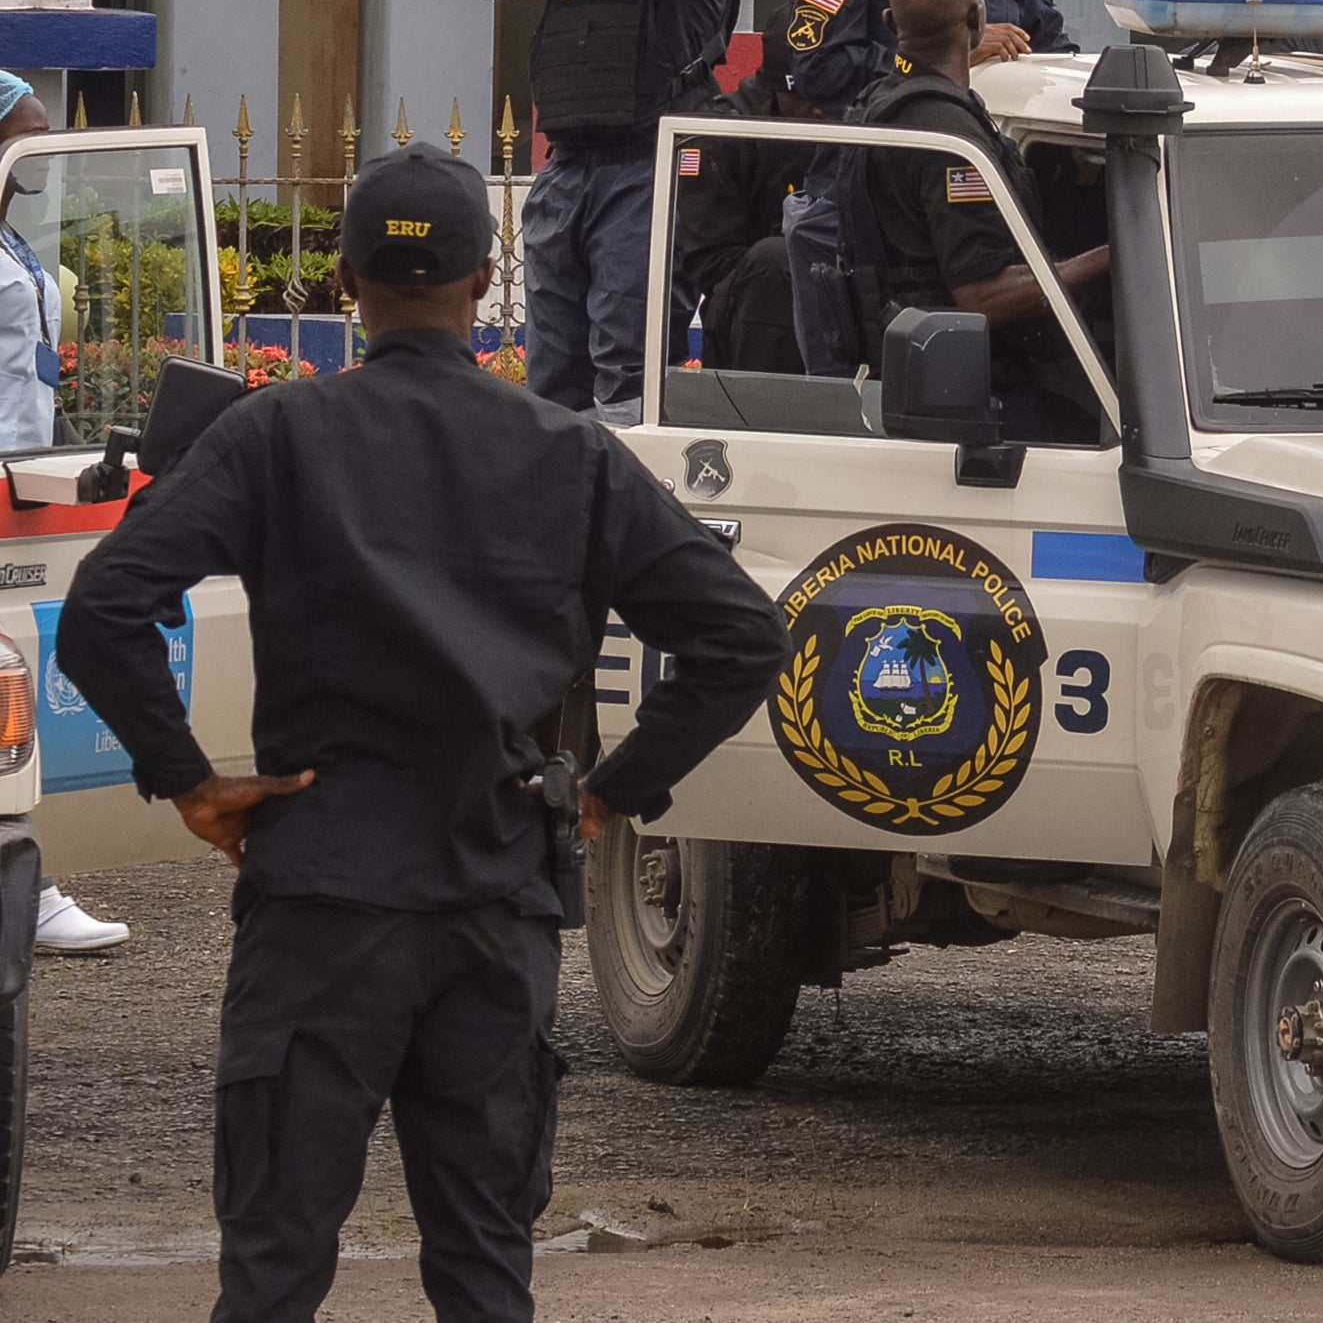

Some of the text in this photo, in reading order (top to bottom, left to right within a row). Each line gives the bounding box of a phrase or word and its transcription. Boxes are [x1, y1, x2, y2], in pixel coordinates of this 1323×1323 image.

[385, 220, 432, 237] ERU
[856, 534, 967, 572] NATIONAL
[971, 561, 1032, 643] POLICE
[887, 607, 920, 615] LIBERTY
[168, 636, 187, 662] lth
[1054, 648, 1110, 734] 3
[888, 749, 923, 767] R.L
